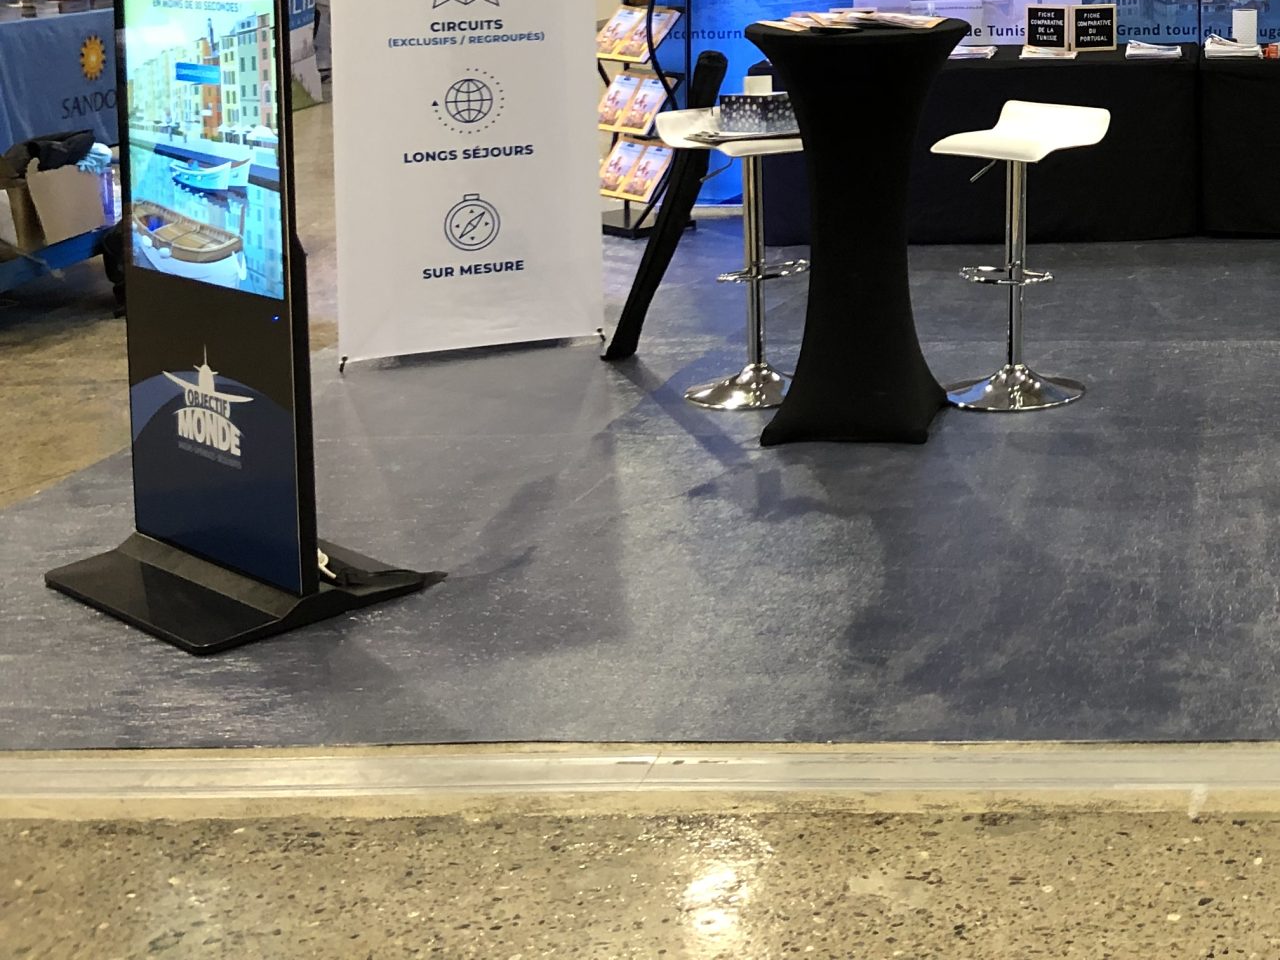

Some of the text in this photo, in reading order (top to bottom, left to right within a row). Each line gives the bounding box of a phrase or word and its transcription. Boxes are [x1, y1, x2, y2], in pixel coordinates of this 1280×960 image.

[430, 19, 503, 32] CIRCUITS
[987, 25, 1025, 36] Tunis
[1117, 24, 1160, 36] Grand
[1166, 25, 1197, 35] tour
[1204, 26, 1221, 37] du
[388, 35, 457, 48] (EXCLUSIFS
[468, 31, 545, 44] REGROUPÉS)
[404, 144, 534, 163] LONGS SÉJOURS
[422, 260, 524, 279] SUR MESURE
[187, 389, 228, 417] OBJECTIF
[178, 410, 241, 456] MONDE
